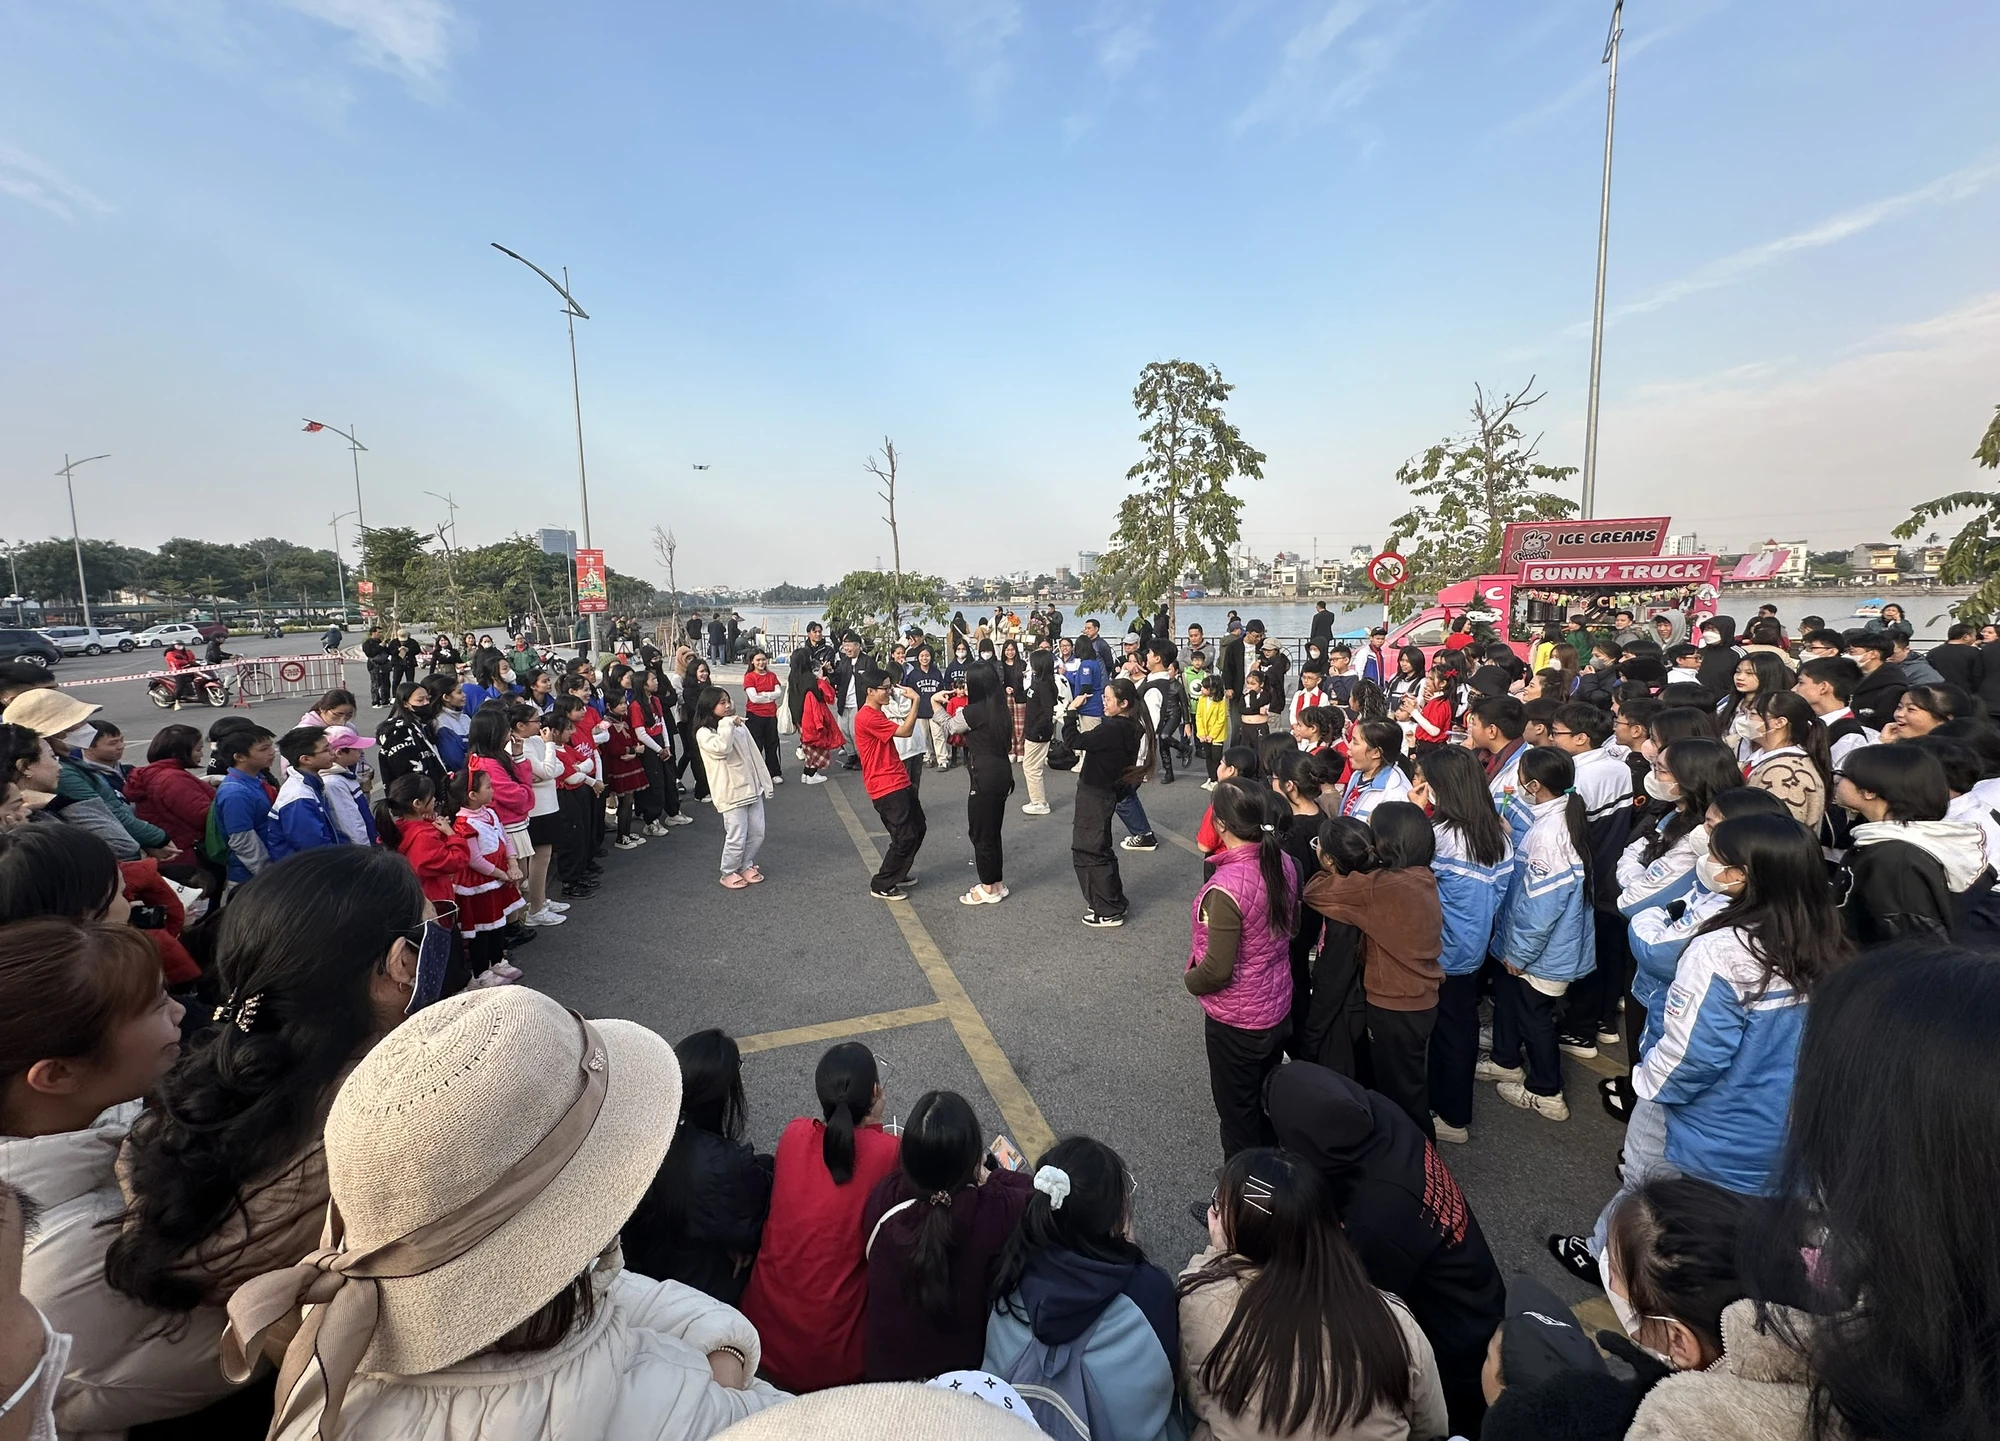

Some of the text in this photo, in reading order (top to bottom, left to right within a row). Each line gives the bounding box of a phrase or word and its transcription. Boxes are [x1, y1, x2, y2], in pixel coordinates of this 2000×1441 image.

[1557, 529, 1658, 545] ICE CREAMS
[1529, 563, 1703, 581] BUNNY TRUCK
[1528, 582, 1700, 609] MERRY CHRISTMAS
